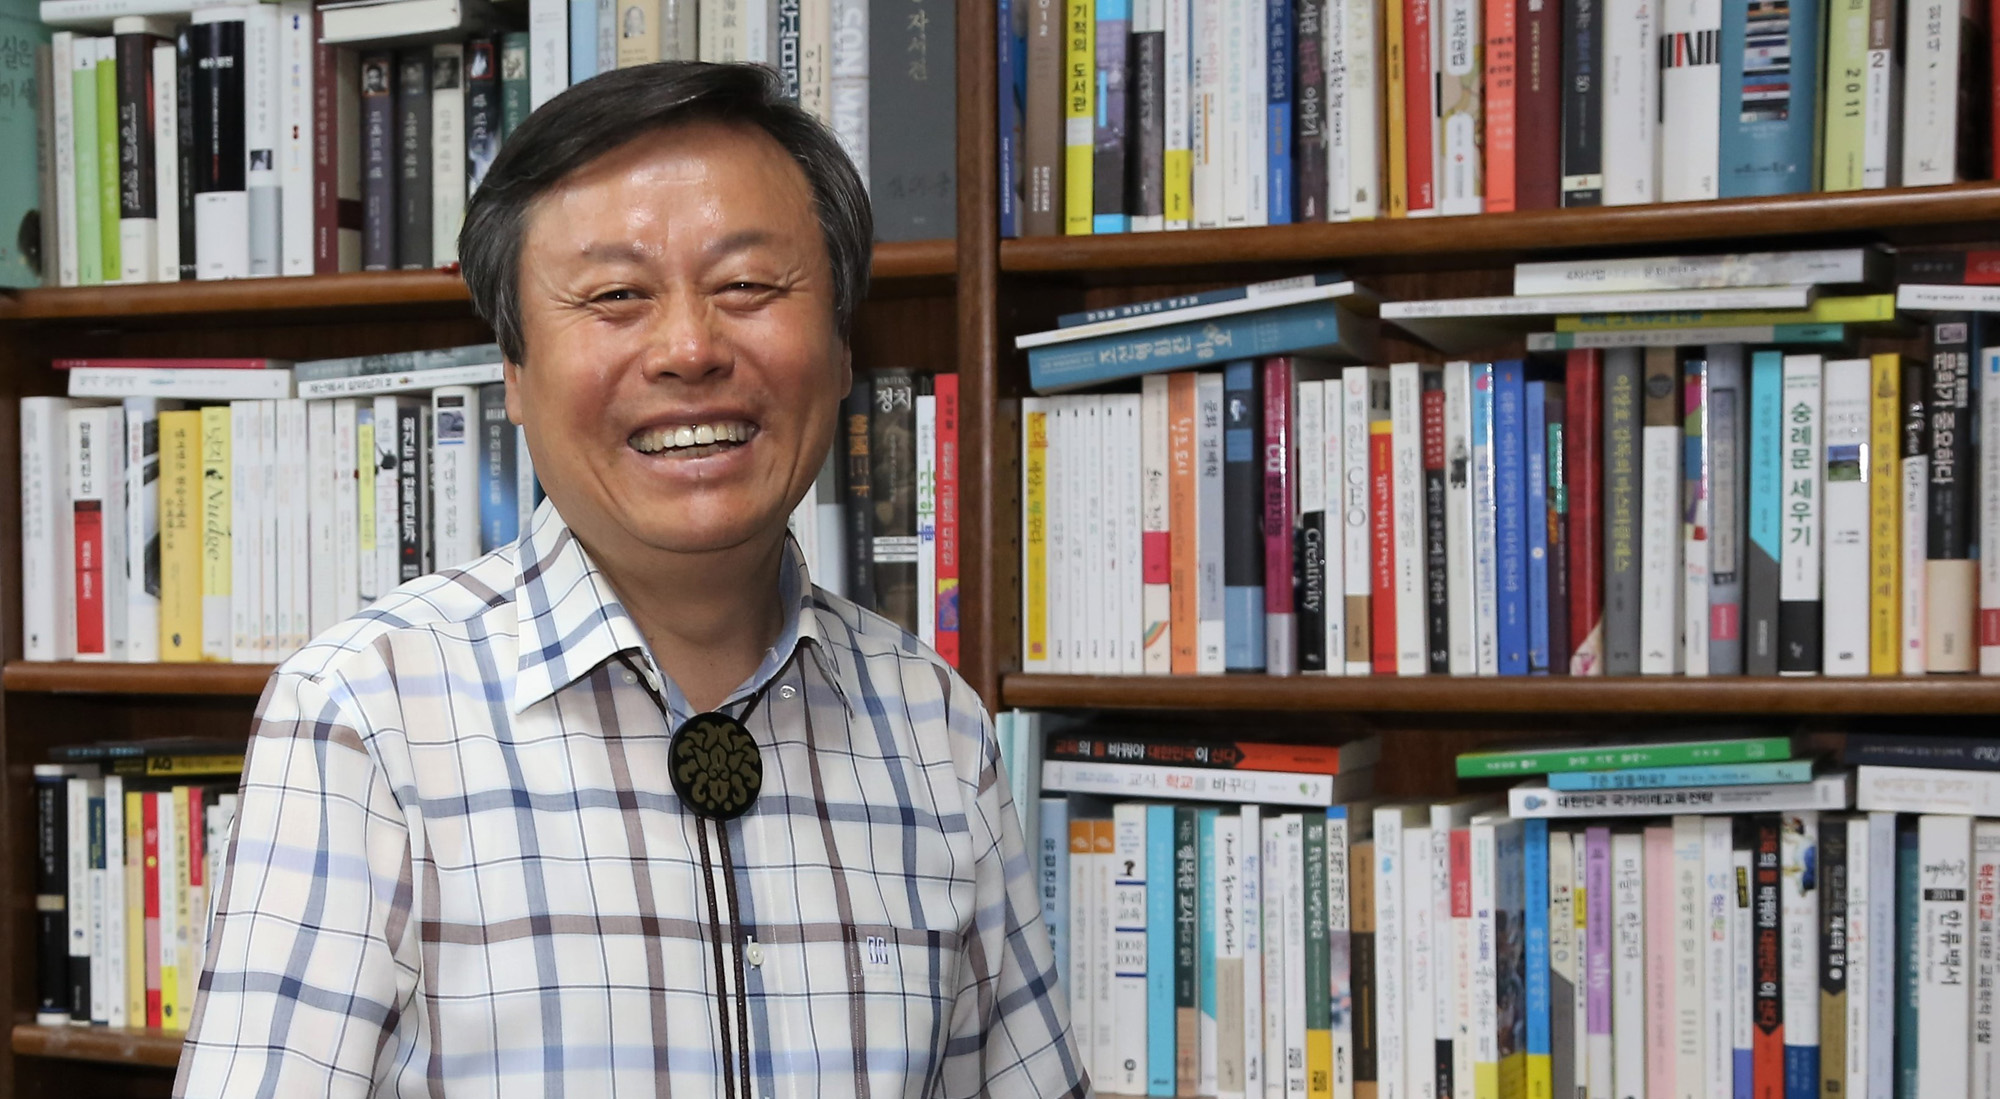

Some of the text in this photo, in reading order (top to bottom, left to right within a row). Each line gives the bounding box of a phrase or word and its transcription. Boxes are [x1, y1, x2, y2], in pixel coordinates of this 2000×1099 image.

[907, 9, 930, 82] 자서전
[1073, 5, 1088, 112] 기적의 도서관
[1452, 8, 1467, 67] 저작권법
[1871, 51, 1886, 69] 2
[1576, 75, 1591, 93] 50
[1845, 67, 1861, 120] 2011
[1302, 86, 1319, 136] 이야기
[874, 386, 913, 414] 정치
[1931, 351, 1957, 486] 문화가 중요하다
[79, 421, 91, 478] 만들어진
[1203, 401, 1218, 477] 문화 경제학
[1502, 432, 1516, 467] 어디서
[401, 416, 417, 544] 위기는 왜 반복되는가
[1346, 465, 1366, 528] CEO
[1503, 470, 1517, 503] 무엇이
[1613, 374, 1631, 572] 이장호 감독의 마스터클래스
[1790, 401, 1813, 547] 숭례문 세우기
[205, 484, 226, 561] Nudge
[1504, 505, 1518, 530] 되어
[1879, 483, 1893, 536] 돌아온
[1504, 531, 1518, 555] 다시
[1303, 527, 1322, 613] Creativity
[1504, 557, 1518, 592] 만나랴
[1879, 543, 1893, 599] 문화재
[151, 758, 172, 771] AQ
[1055, 739, 1091, 757] 교육의
[1107, 742, 1146, 760] 바꿔야
[1148, 745, 1209, 763] 대한민국이
[1211, 749, 1237, 764] 산다
[1165, 773, 1206, 790] 학교를
[1211, 775, 1257, 793] 바꾸다
[1557, 789, 1714, 809] 대한민국 국가미래교육전략
[1118, 890, 1142, 905] 우리
[1118, 907, 1141, 922] 교육
[1177, 819, 1195, 967] 나는 행복한 교사이고 싶다
[1617, 858, 1642, 960] 마을이 학교다
[1758, 885, 1778, 928] 바꿔야
[1978, 864, 1994, 933] 혁신학교에
[1831, 915, 1846, 951] 제4의
[1939, 908, 1962, 986] 한류백서
[1979, 934, 1993, 959] 대한
[1589, 953, 1610, 990] why
[1758, 929, 1778, 997] 대한민국이
[1978, 963, 1994, 1015] 교육학적
